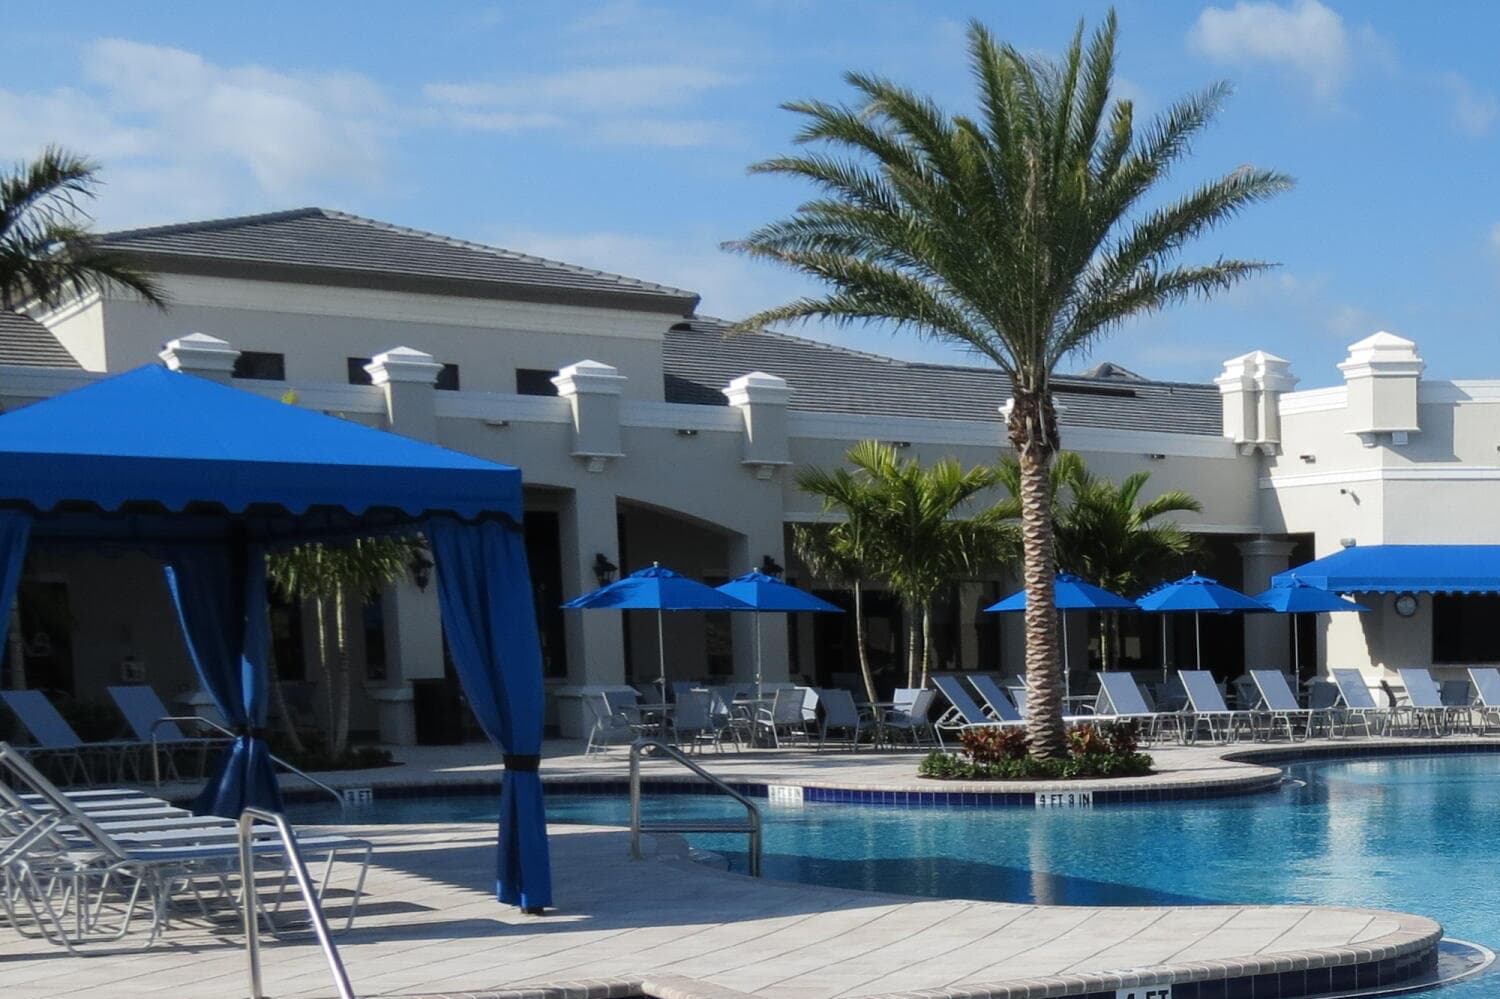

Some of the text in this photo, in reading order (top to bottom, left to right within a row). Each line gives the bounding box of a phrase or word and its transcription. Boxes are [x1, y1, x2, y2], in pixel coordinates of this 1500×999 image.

[1040, 793, 1090, 805] 4 FT 3 IN
